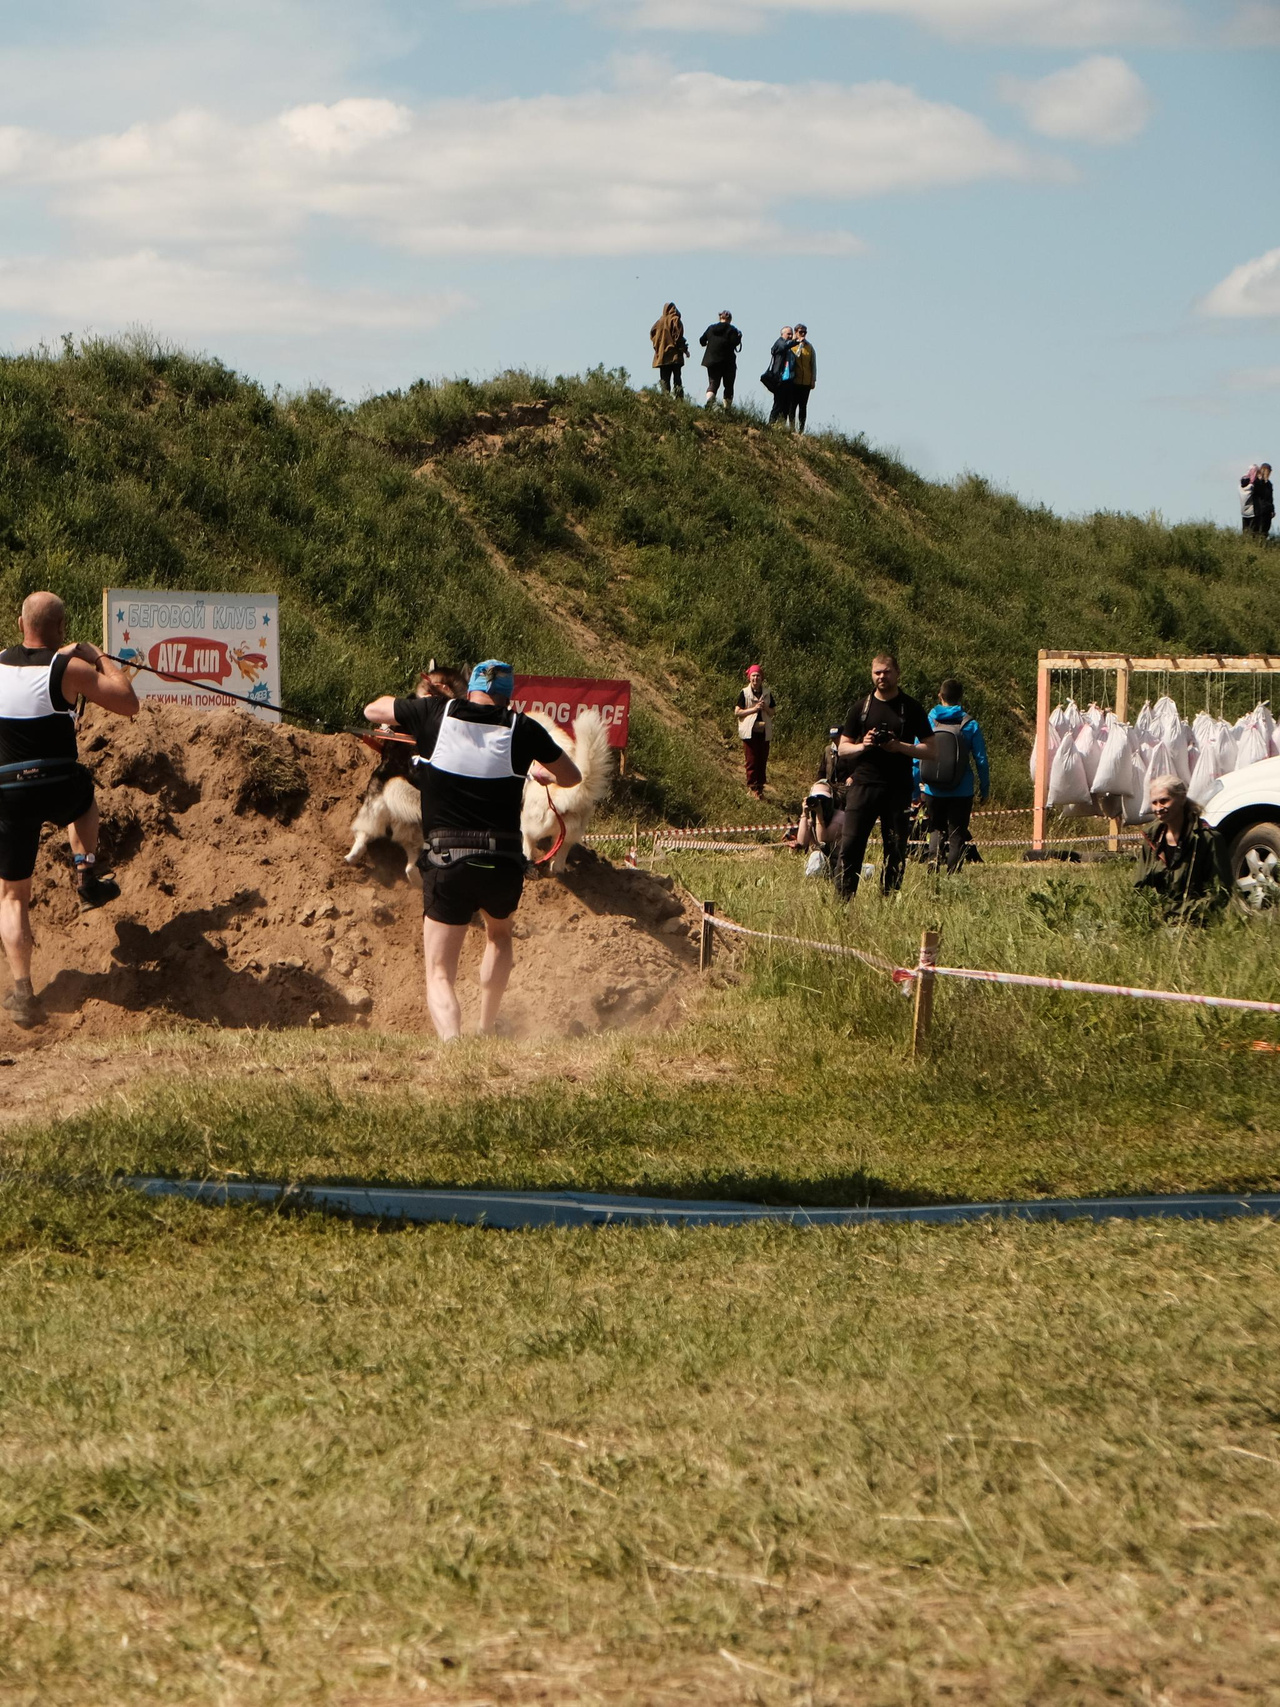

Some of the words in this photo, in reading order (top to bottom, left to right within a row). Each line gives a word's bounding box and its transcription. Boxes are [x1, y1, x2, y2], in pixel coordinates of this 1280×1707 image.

[128, 600, 206, 629] БЕГОВОЙ
[213, 606, 257, 630] КЛУБ
[157, 643, 220, 673] AVZ.run
[180, 694, 193, 706] НА
[195, 694, 237, 708] ПОМОЩЬ
[530, 701, 571, 723] DOG
